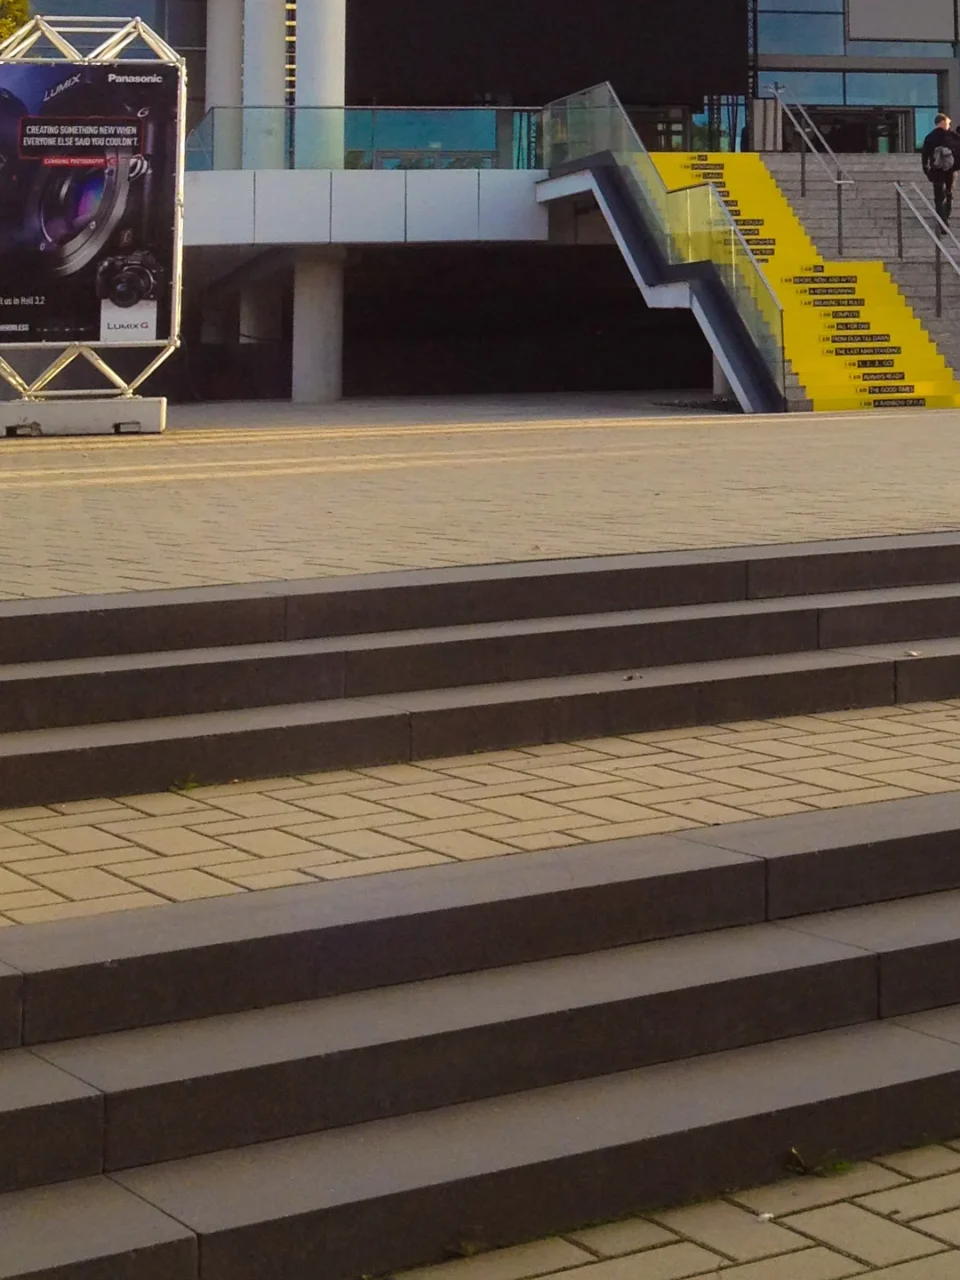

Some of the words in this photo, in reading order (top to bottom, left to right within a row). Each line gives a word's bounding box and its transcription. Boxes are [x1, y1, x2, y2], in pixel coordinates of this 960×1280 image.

[107, 73, 163, 83] Panasonic
[43, 73, 82, 102] LUMIX
[26, 125, 59, 135] CREATING
[60, 125, 98, 135] SOMETHING
[99, 125, 116, 135] NEW
[116, 125, 137, 135] WHEN
[23, 136, 56, 146] EVERYONE
[57, 136, 73, 146] ELSE
[74, 136, 90, 146] SAID
[91, 136, 104, 146] YOU
